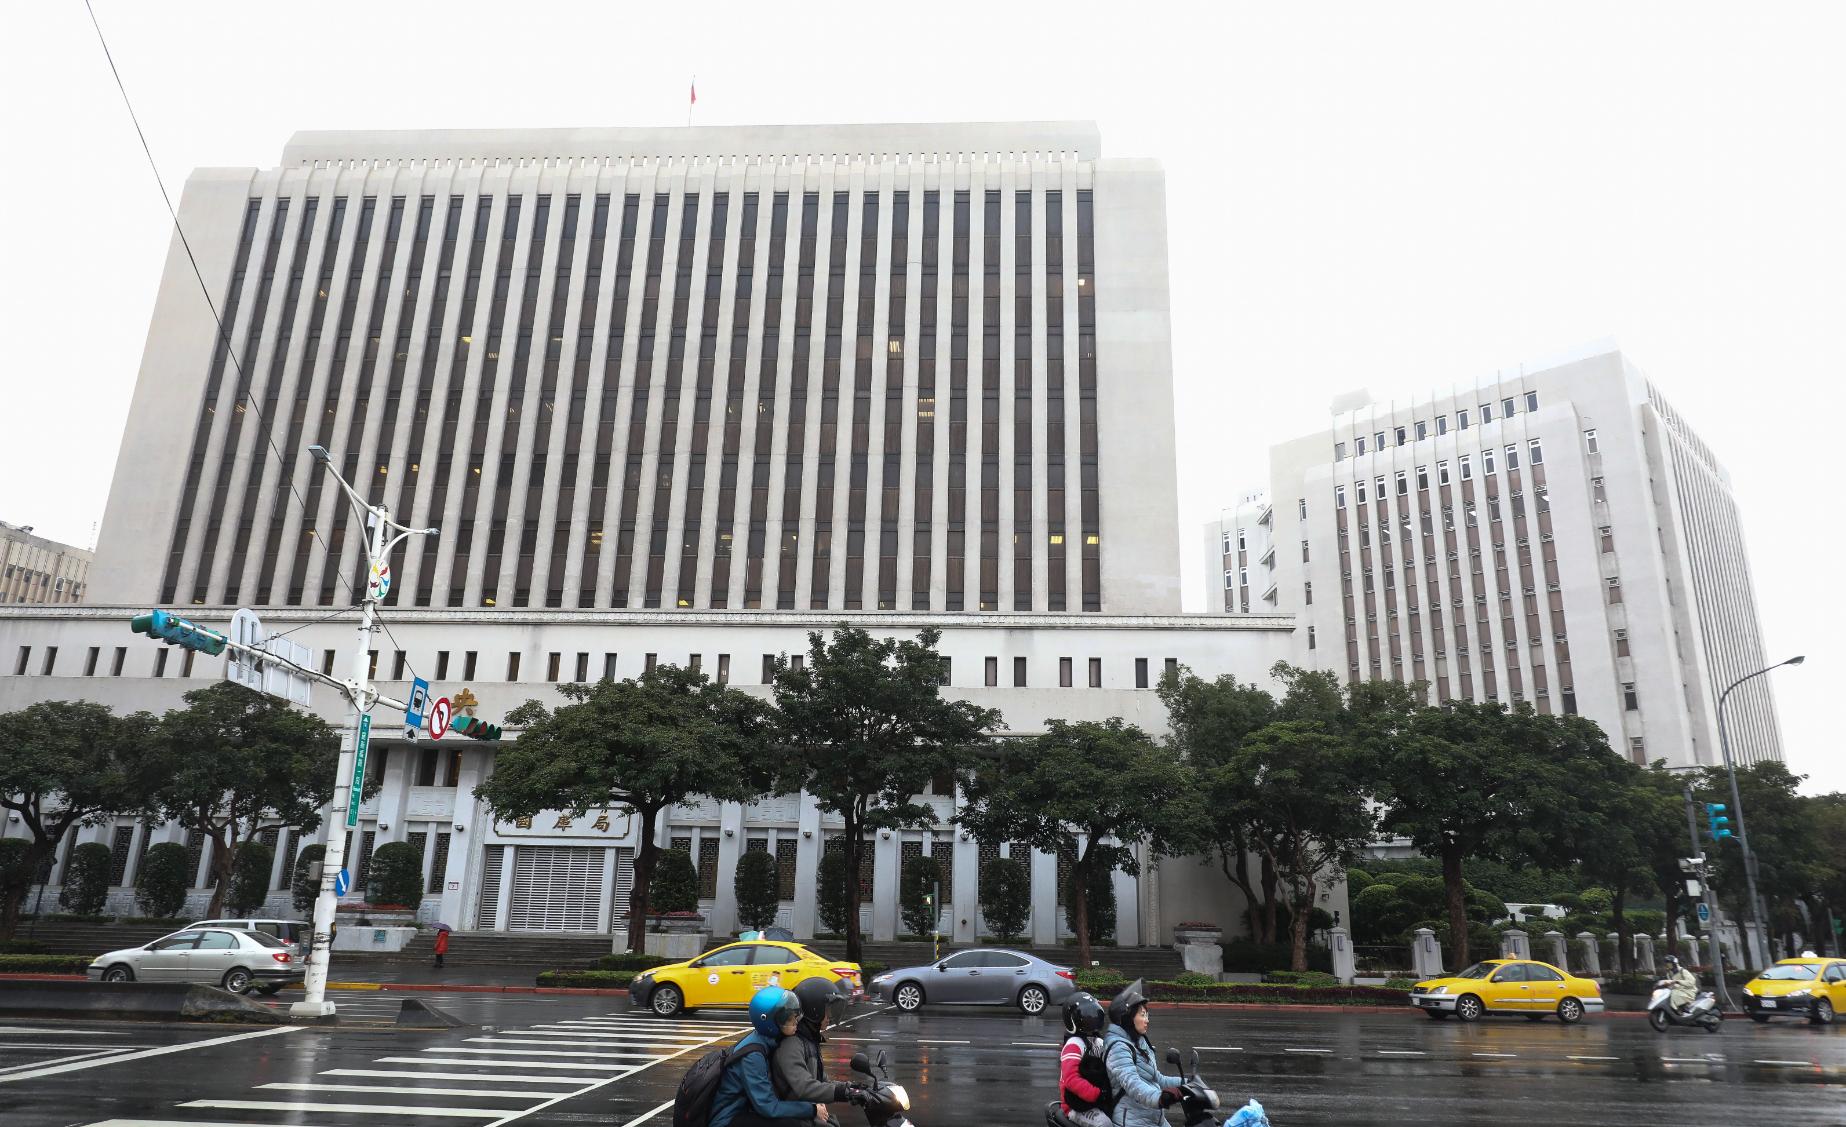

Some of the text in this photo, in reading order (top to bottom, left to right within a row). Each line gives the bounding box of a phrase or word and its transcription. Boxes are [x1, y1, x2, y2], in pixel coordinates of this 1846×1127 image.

[451, 688, 478, 716] 央
[515, 813, 610, 832] 國庫局
